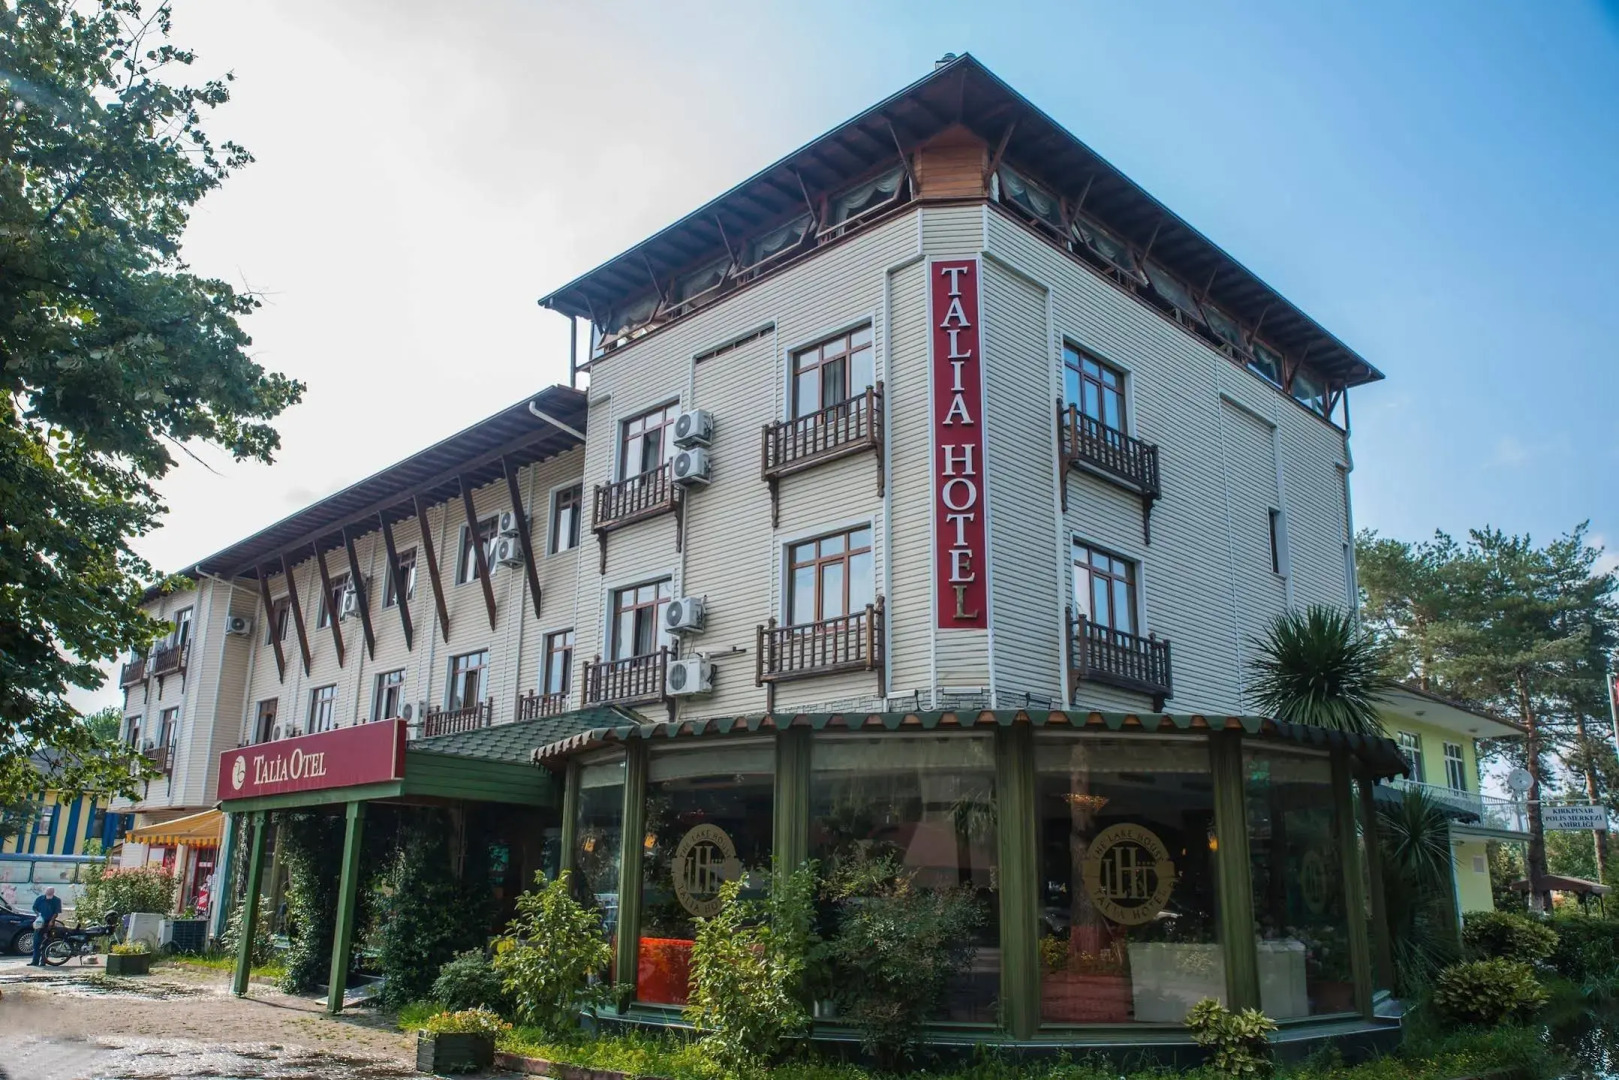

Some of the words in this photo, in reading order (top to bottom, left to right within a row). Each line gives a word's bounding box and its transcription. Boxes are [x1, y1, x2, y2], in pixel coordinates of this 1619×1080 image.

[940, 265, 975, 426] TALIA
[942, 443, 979, 620] HOTEL
[290, 748, 327, 779] OTEL
[692, 829, 710, 841] LAKE
[1107, 829, 1133, 841] LAKE
